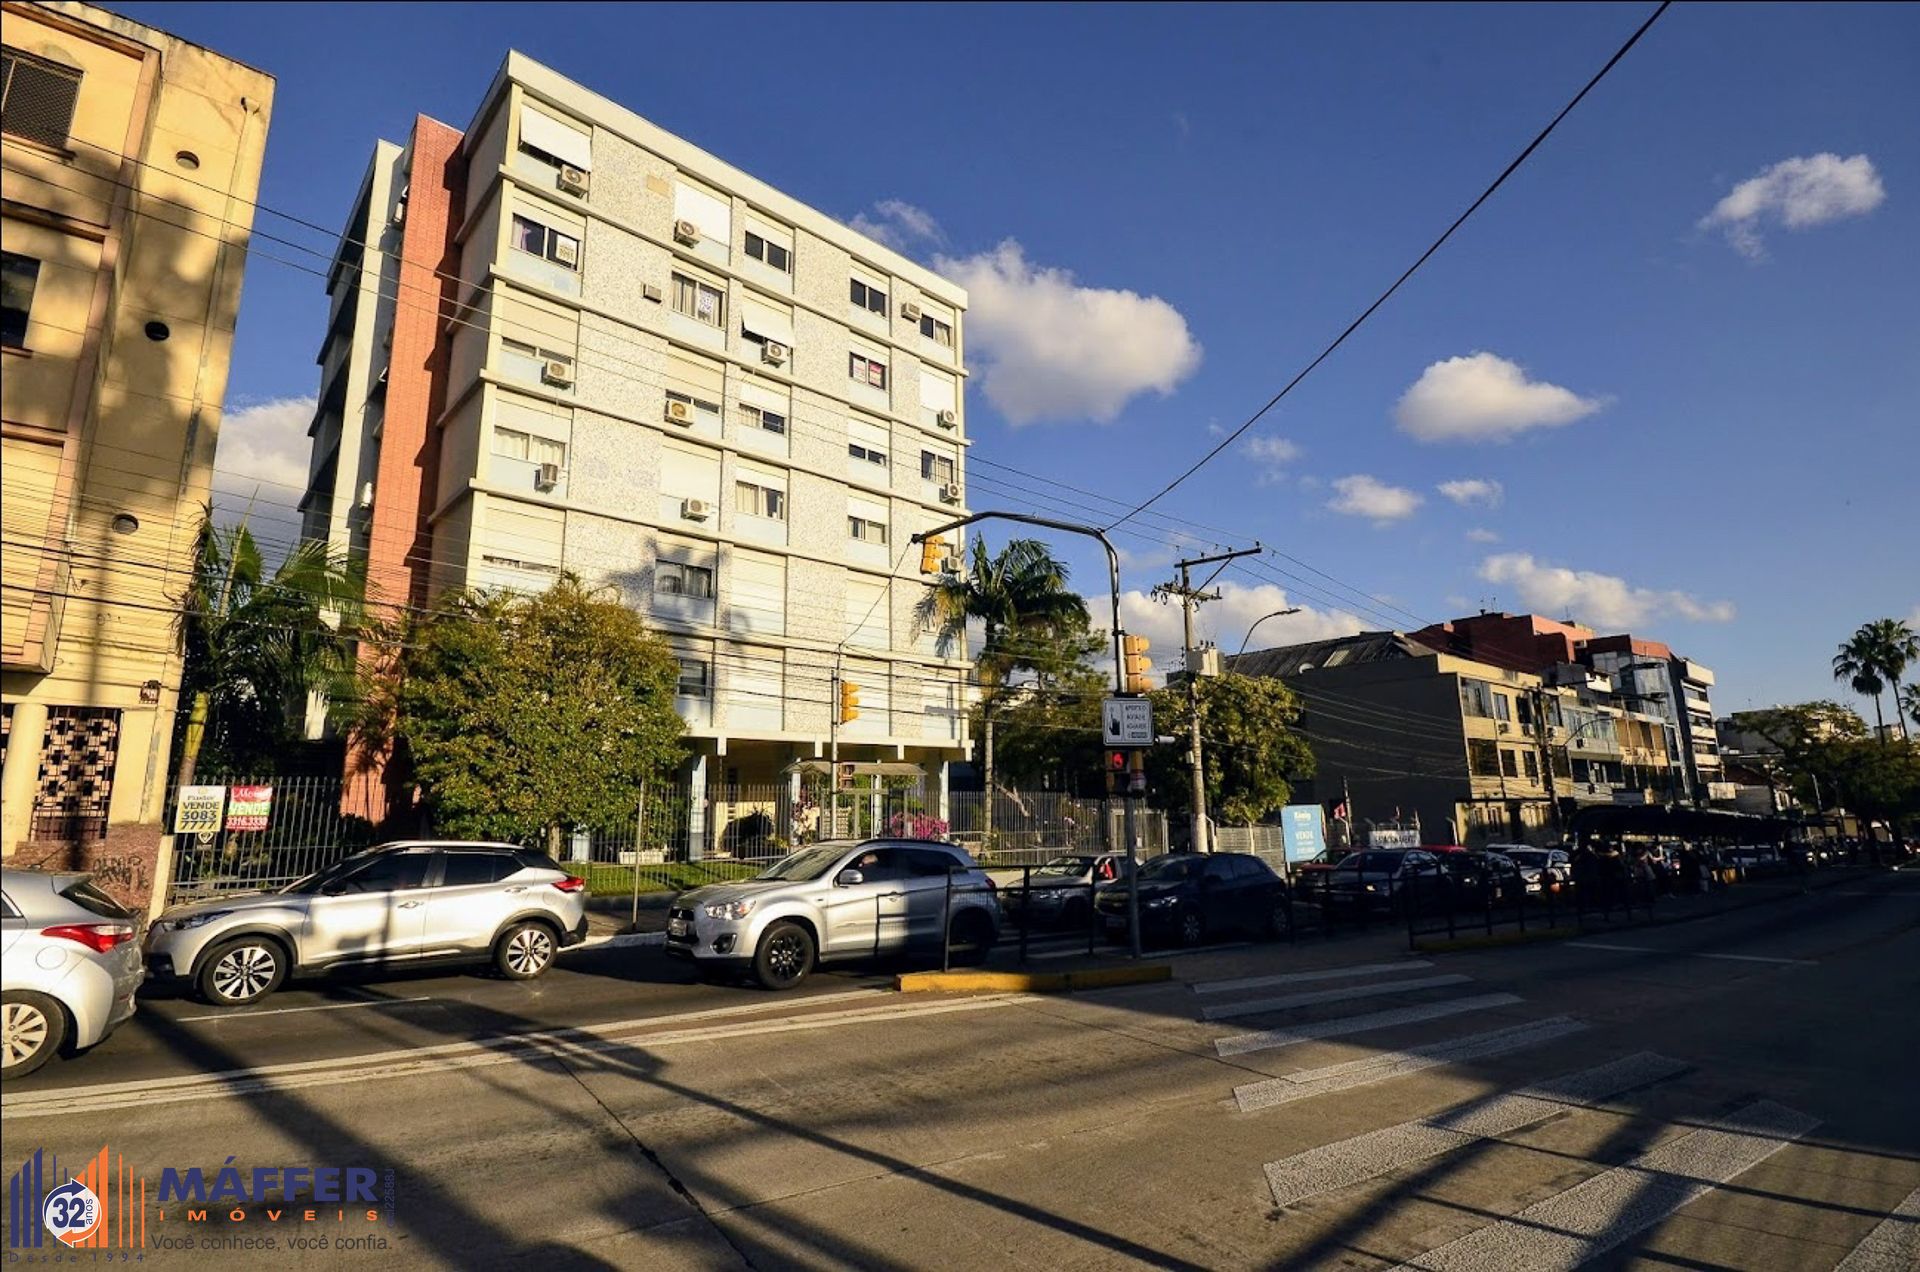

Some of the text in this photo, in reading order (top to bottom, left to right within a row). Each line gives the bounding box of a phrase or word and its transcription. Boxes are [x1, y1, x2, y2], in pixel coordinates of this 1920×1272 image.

[182, 801, 220, 810] VENDE
[230, 802, 269, 815] VENDE
[181, 810, 217, 820] 3083
[180, 820, 217, 830] 7777
